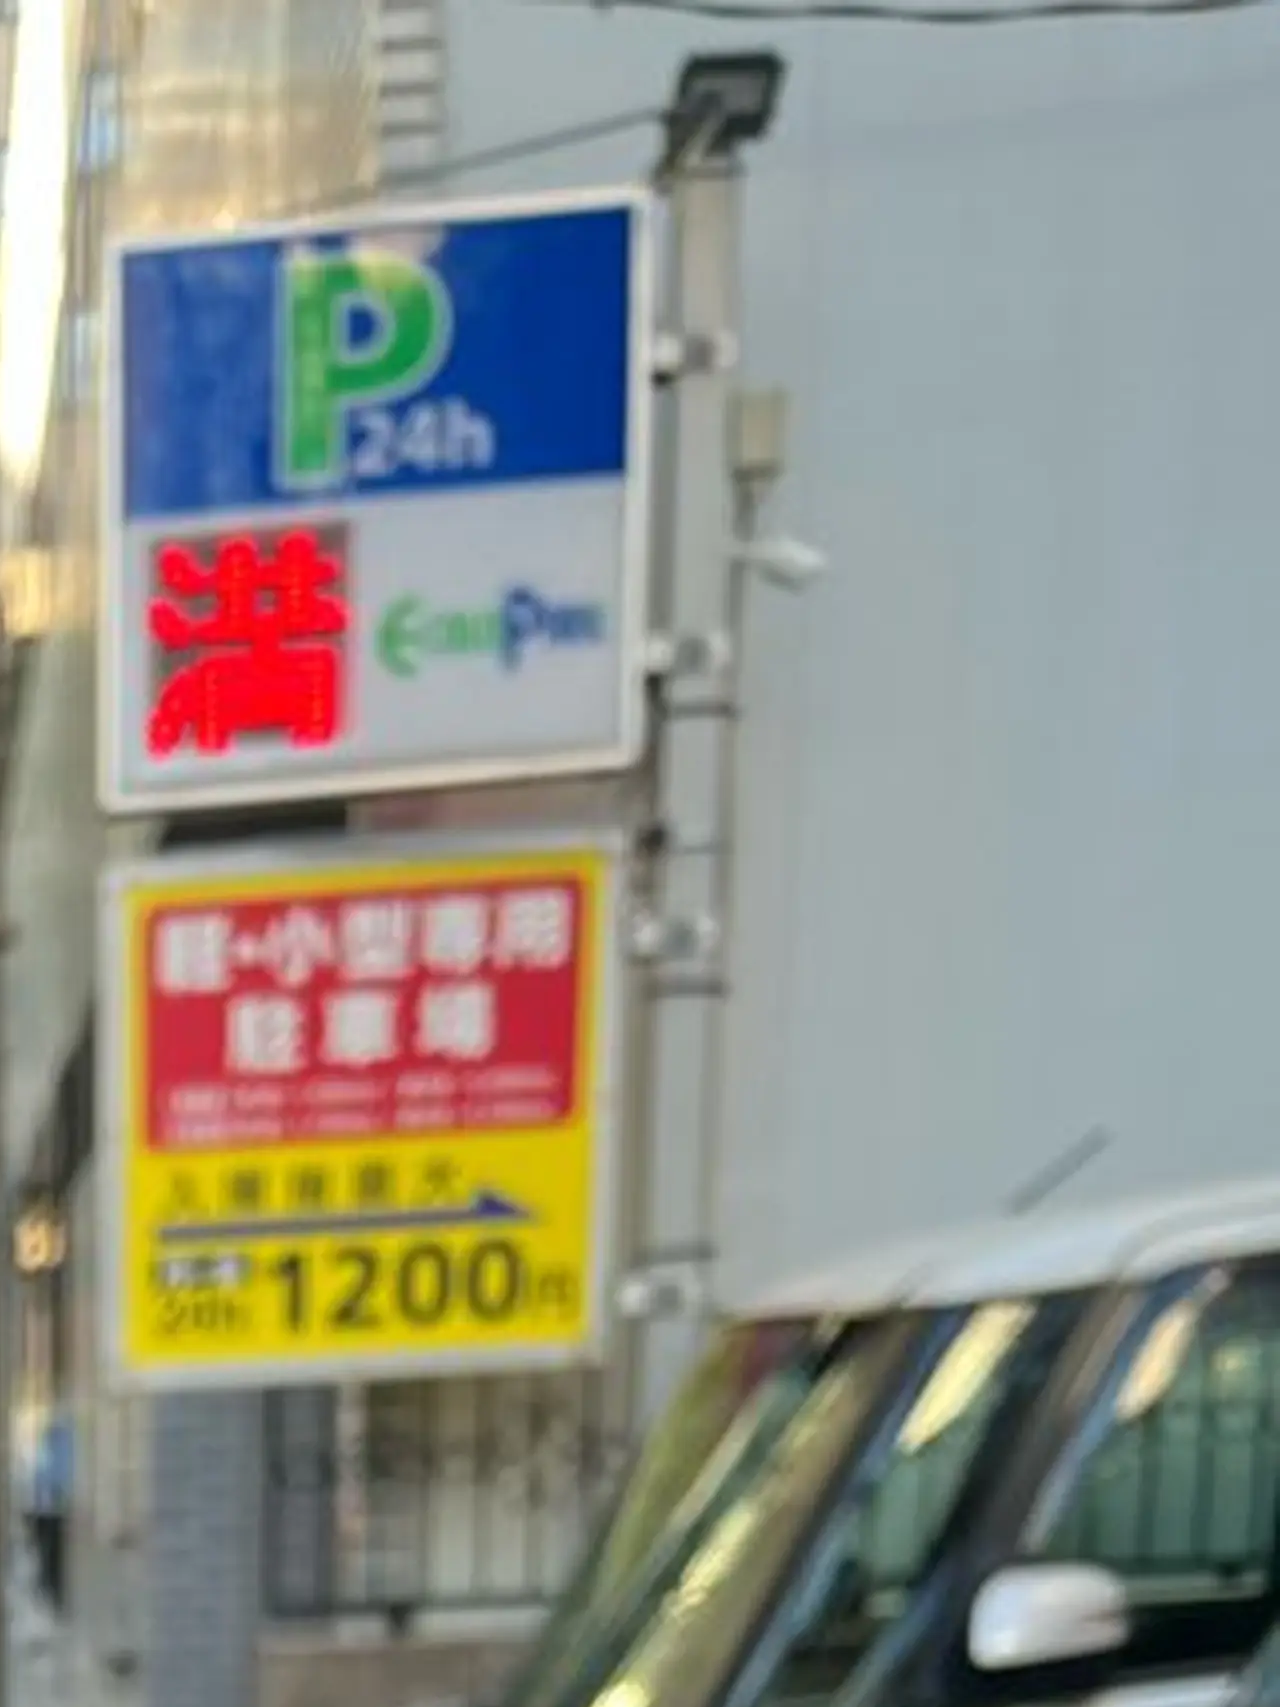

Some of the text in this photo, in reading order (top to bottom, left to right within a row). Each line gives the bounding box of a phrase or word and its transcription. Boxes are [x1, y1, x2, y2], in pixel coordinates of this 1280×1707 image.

[274, 246, 452, 490] P
[350, 400, 496, 478] 24h
[147, 529, 350, 758] 満
